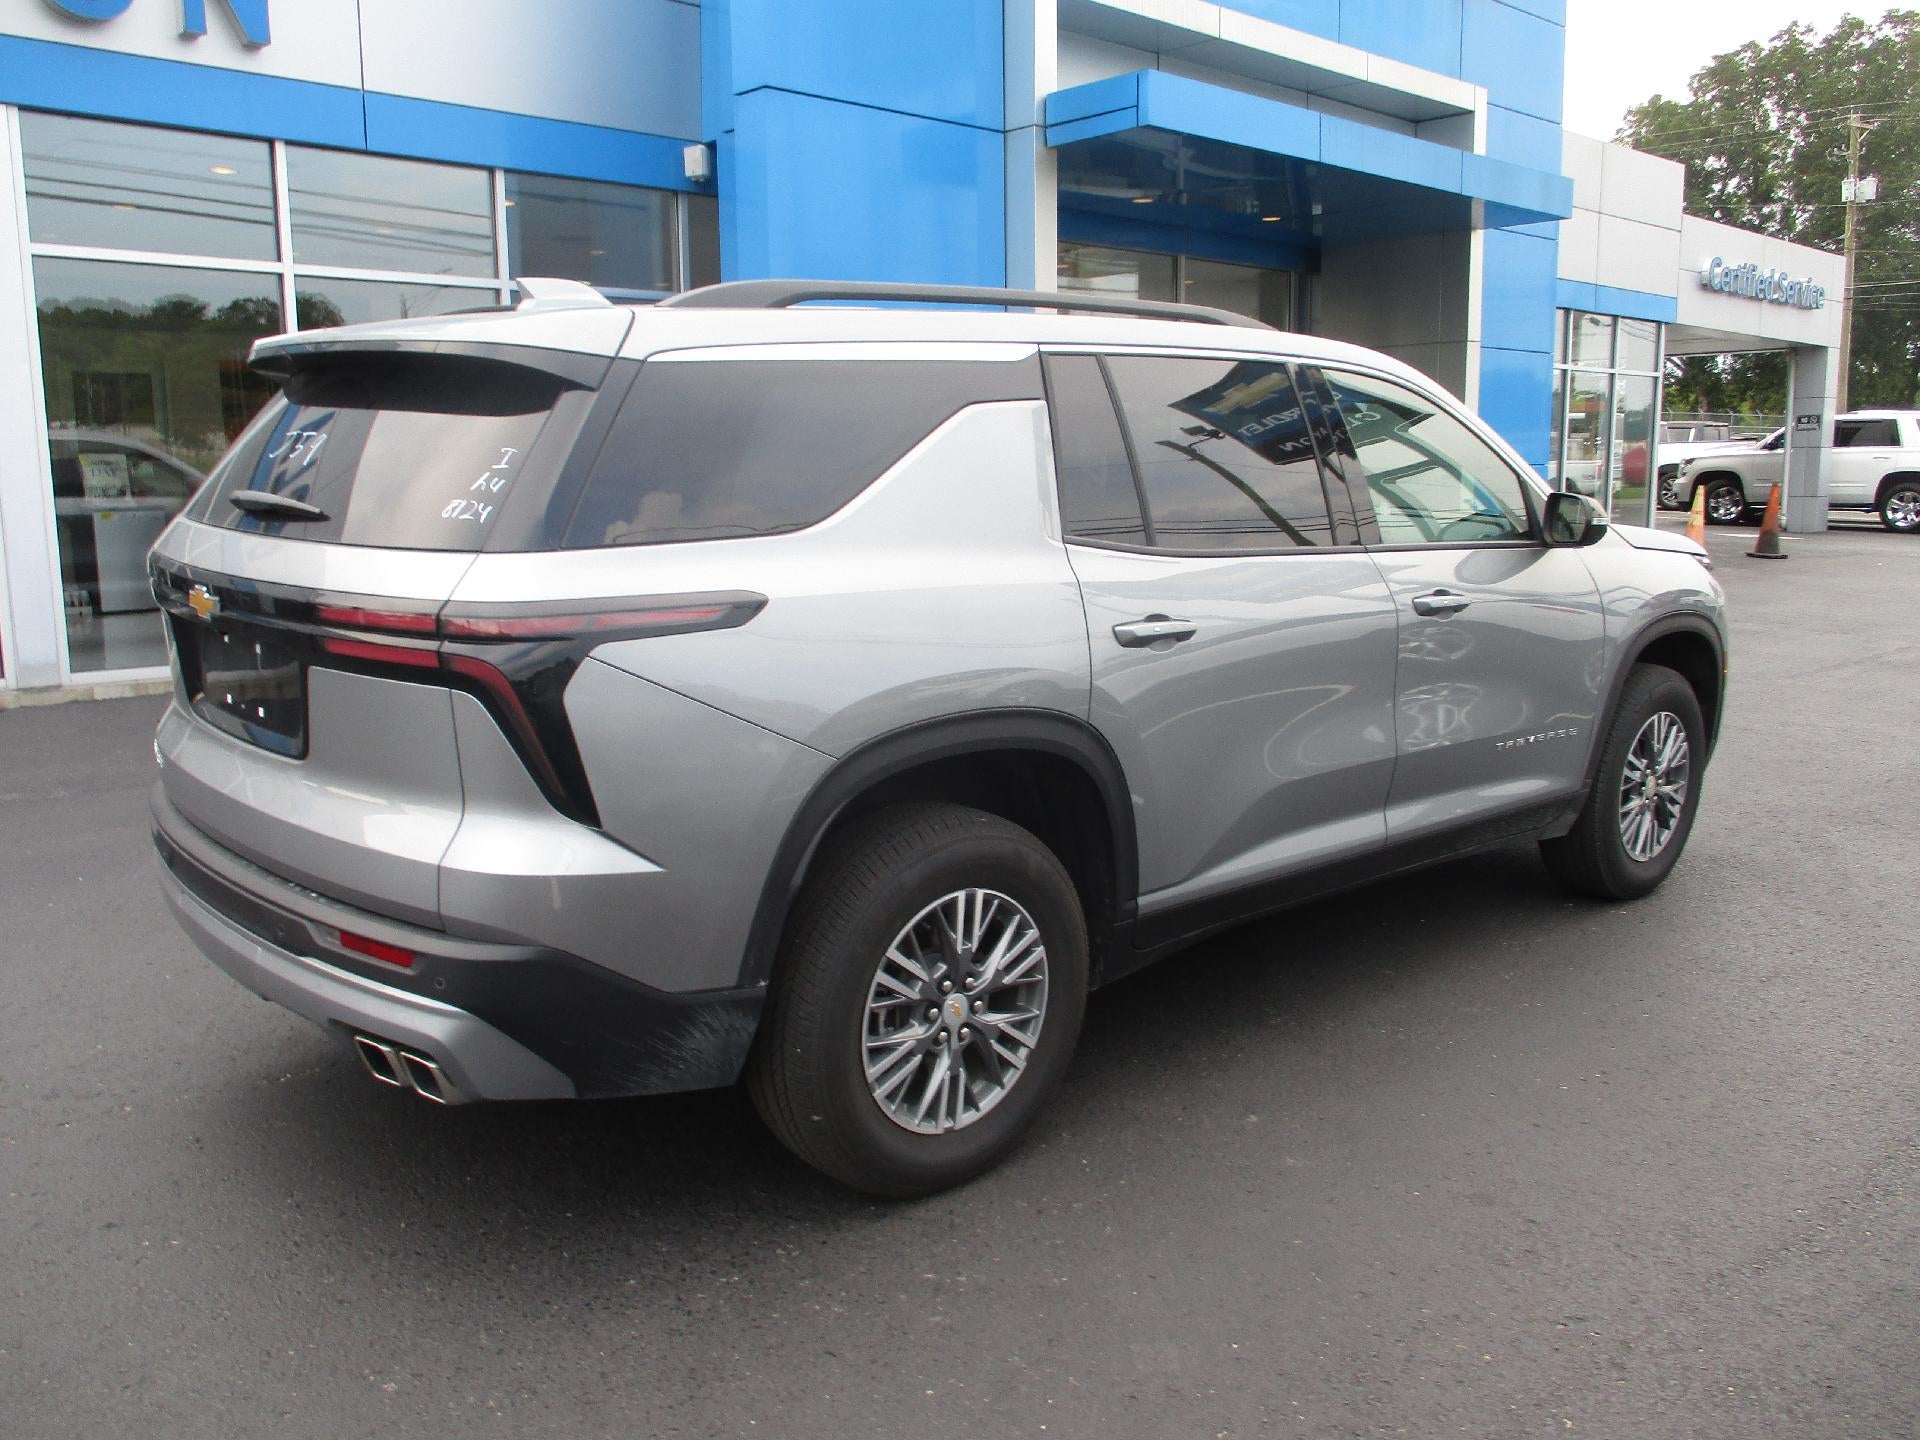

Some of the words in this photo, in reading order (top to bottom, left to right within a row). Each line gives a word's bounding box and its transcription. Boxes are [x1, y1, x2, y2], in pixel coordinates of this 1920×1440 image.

[1709, 257, 1775, 300] Certified
[1778, 271, 1825, 309] Service
[1495, 727, 1578, 751] TRAVERSE
